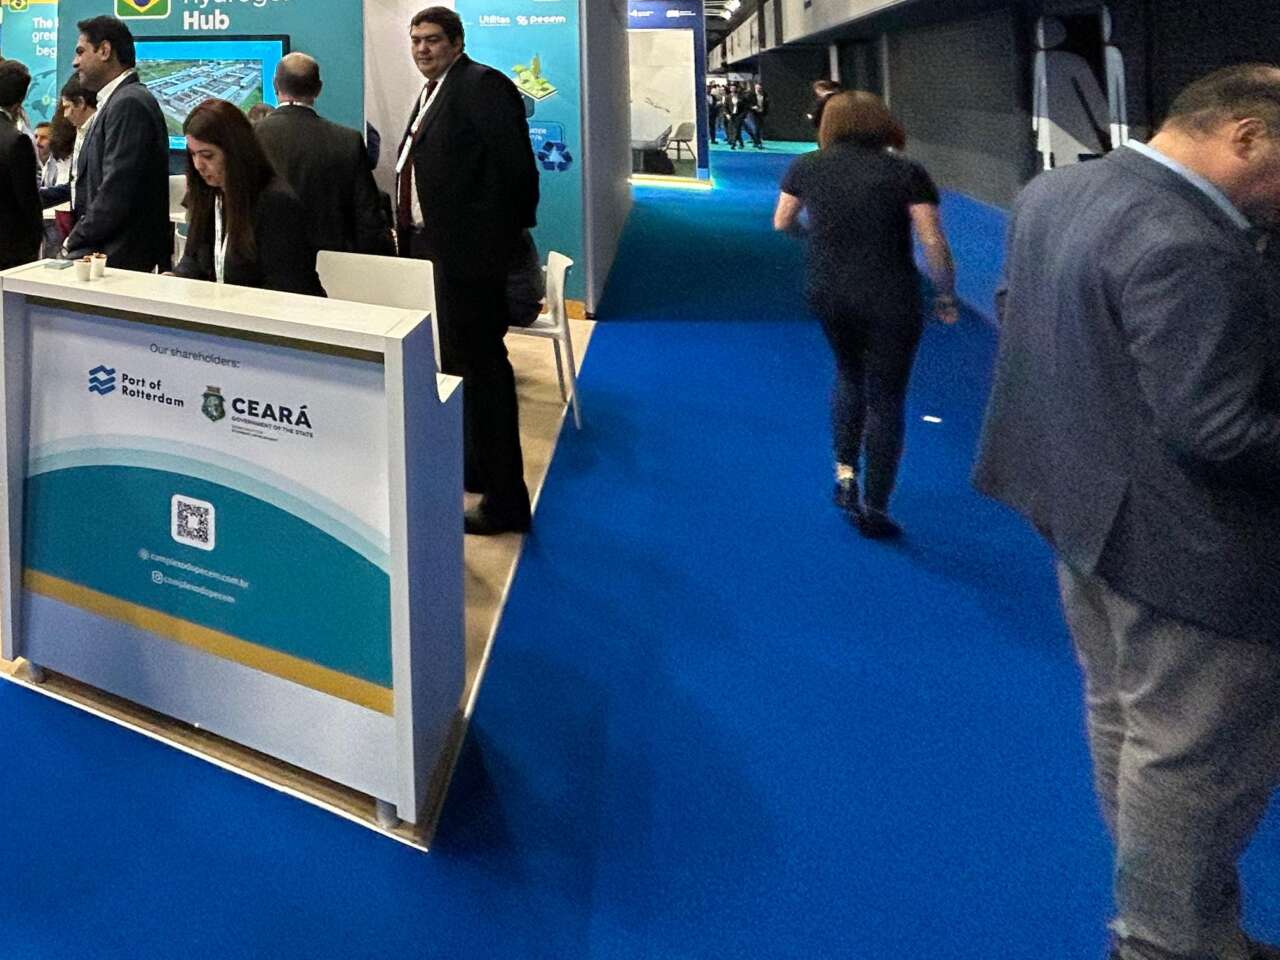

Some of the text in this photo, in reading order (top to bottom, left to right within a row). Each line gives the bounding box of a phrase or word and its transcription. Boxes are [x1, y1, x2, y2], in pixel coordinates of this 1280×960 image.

[32, 16, 53, 29] The
[183, 9, 230, 31] Hub
[32, 32, 57, 44] gree
[36, 44, 57, 58] beg
[150, 343, 241, 369] Our shareholders:
[122, 373, 162, 390] Port of
[122, 385, 184, 407] Rotterdam
[231, 397, 312, 429] CEARÁ
